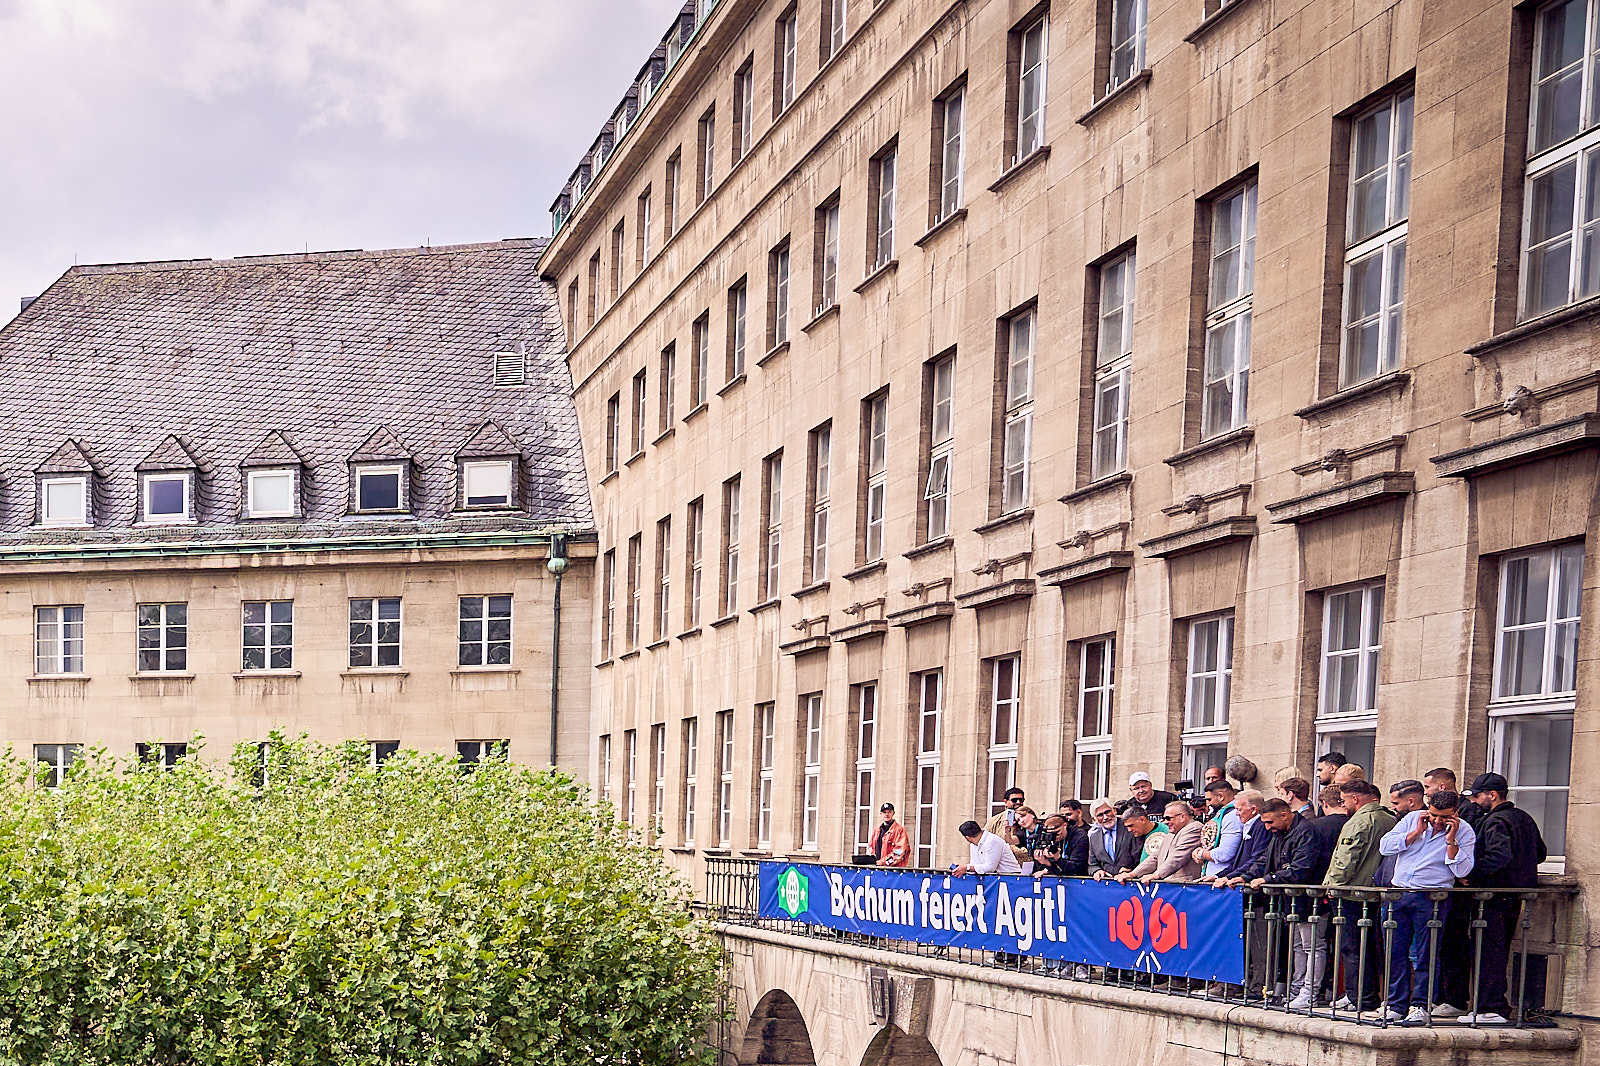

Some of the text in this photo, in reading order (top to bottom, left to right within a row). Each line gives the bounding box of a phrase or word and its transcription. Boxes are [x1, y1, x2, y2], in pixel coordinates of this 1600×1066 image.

[830, 872, 1068, 951] Bochum feiert Agit!
